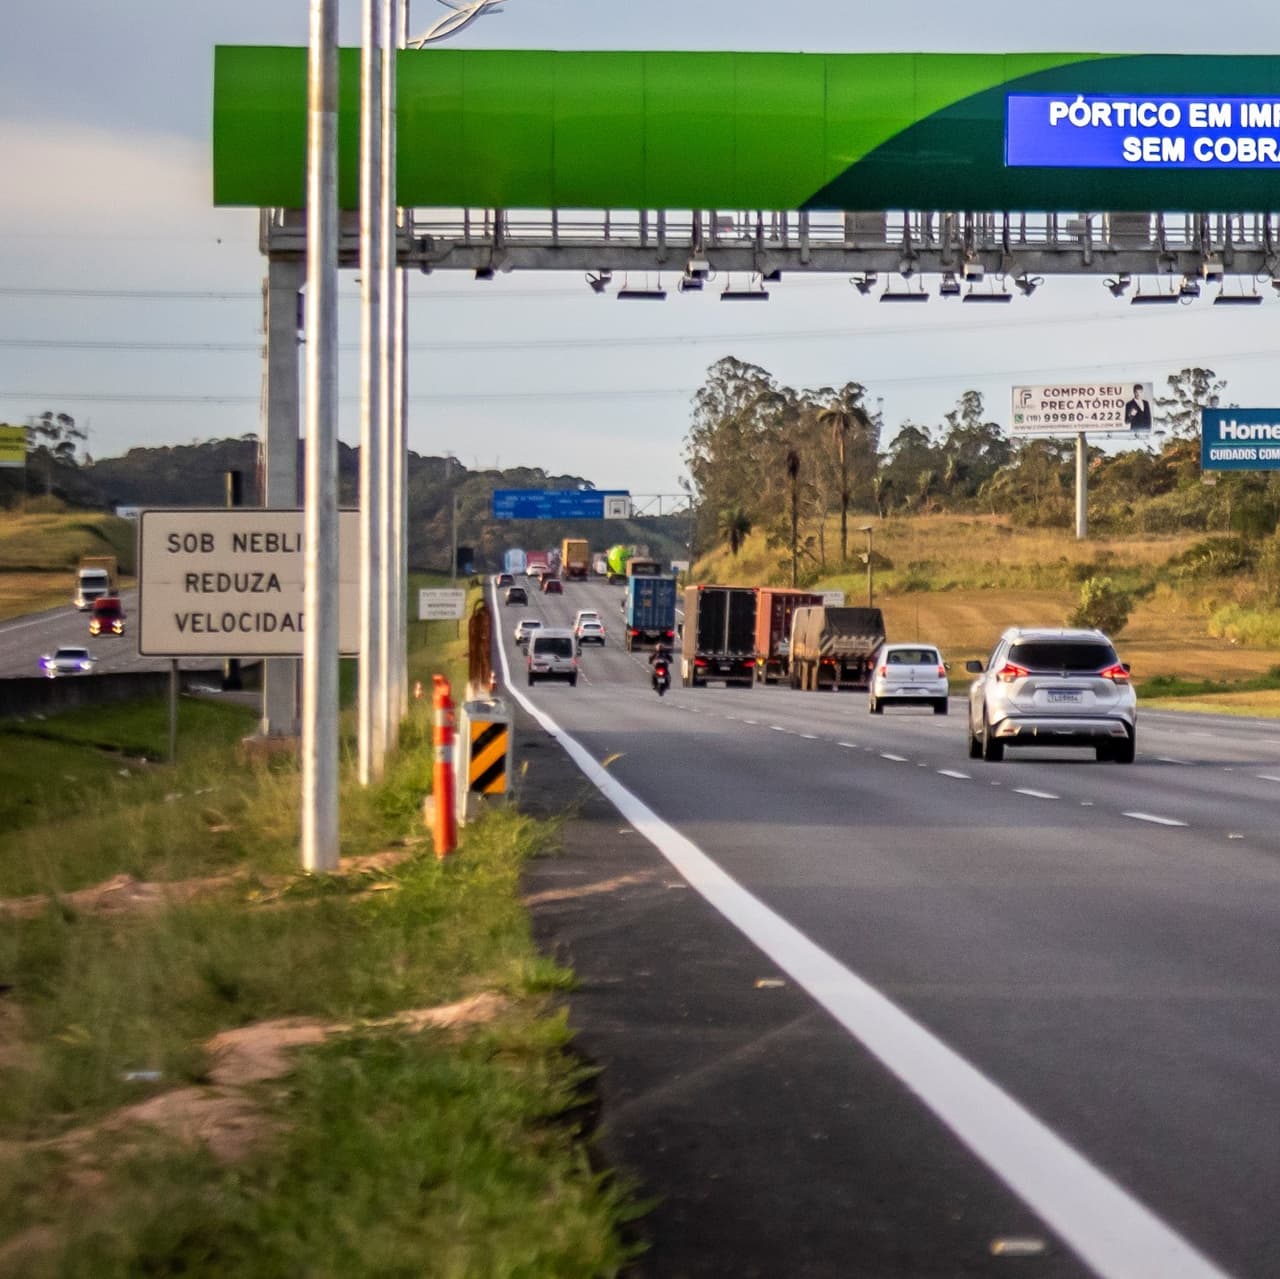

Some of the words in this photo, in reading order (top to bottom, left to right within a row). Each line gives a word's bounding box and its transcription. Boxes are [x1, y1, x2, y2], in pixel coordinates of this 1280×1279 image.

[1050, 96, 1180, 127] PÓRTICO
[1190, 103, 1231, 127] EM
[1123, 137, 1185, 161] SEM
[1044, 388, 1095, 397] COMPRO
[1100, 387, 1122, 395] SEU
[1041, 397, 1124, 410] PRECATÓRIO
[1044, 412, 1120, 422] 99980-4222
[1210, 449, 1256, 460] CUIDADOS
[168, 533, 214, 553] SOB
[233, 533, 302, 553] NEBLI
[185, 573, 281, 593] REDUZA
[175, 612, 304, 633] VELOCIDA
